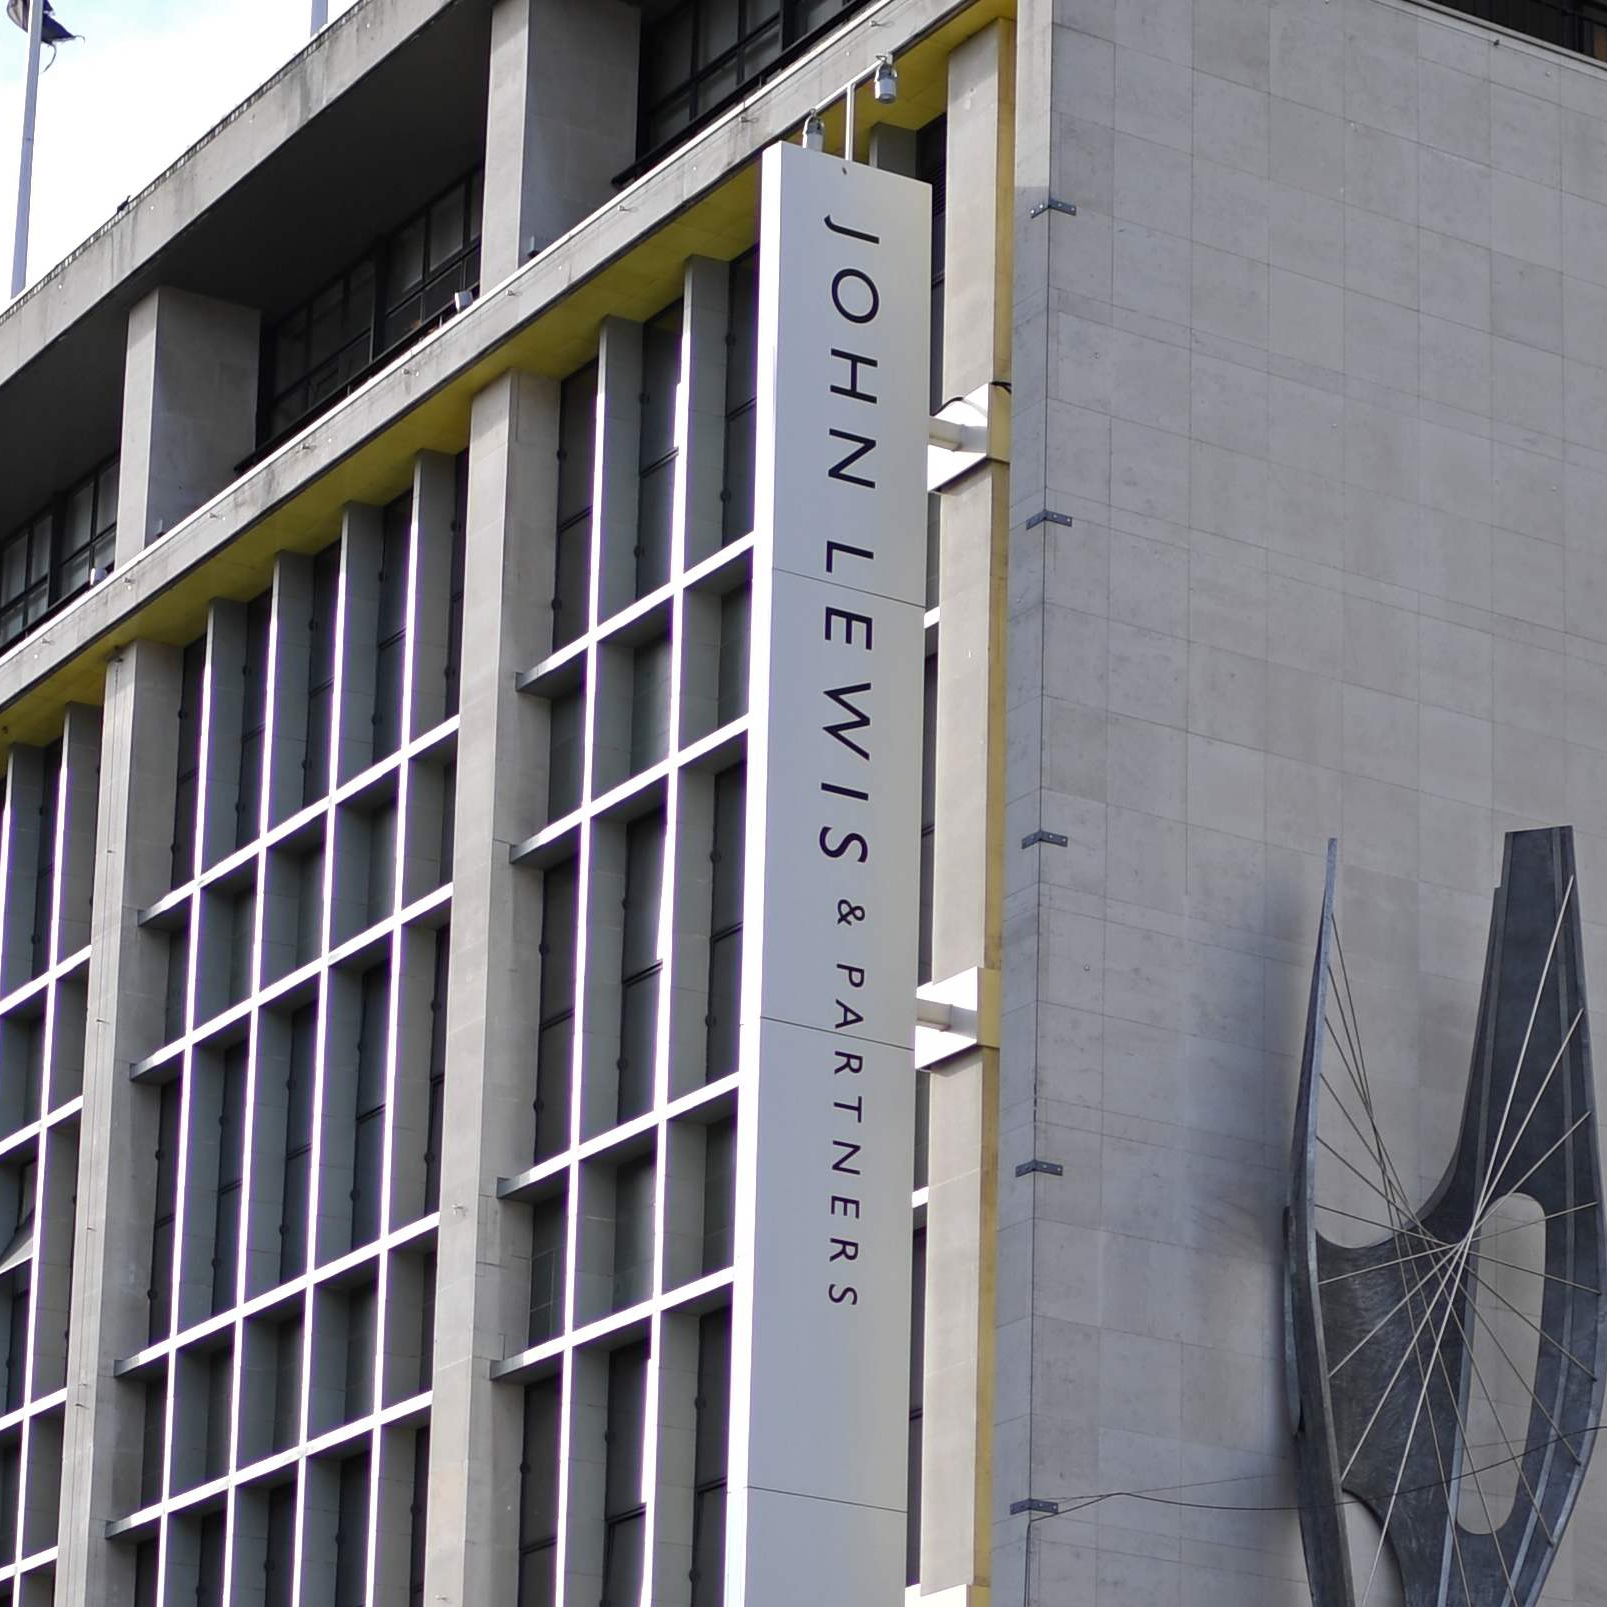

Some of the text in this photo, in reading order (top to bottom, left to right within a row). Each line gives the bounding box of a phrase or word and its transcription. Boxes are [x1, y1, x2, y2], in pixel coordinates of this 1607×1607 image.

[819, 214, 880, 1306] JOHN LEWIS & PARTNERS
